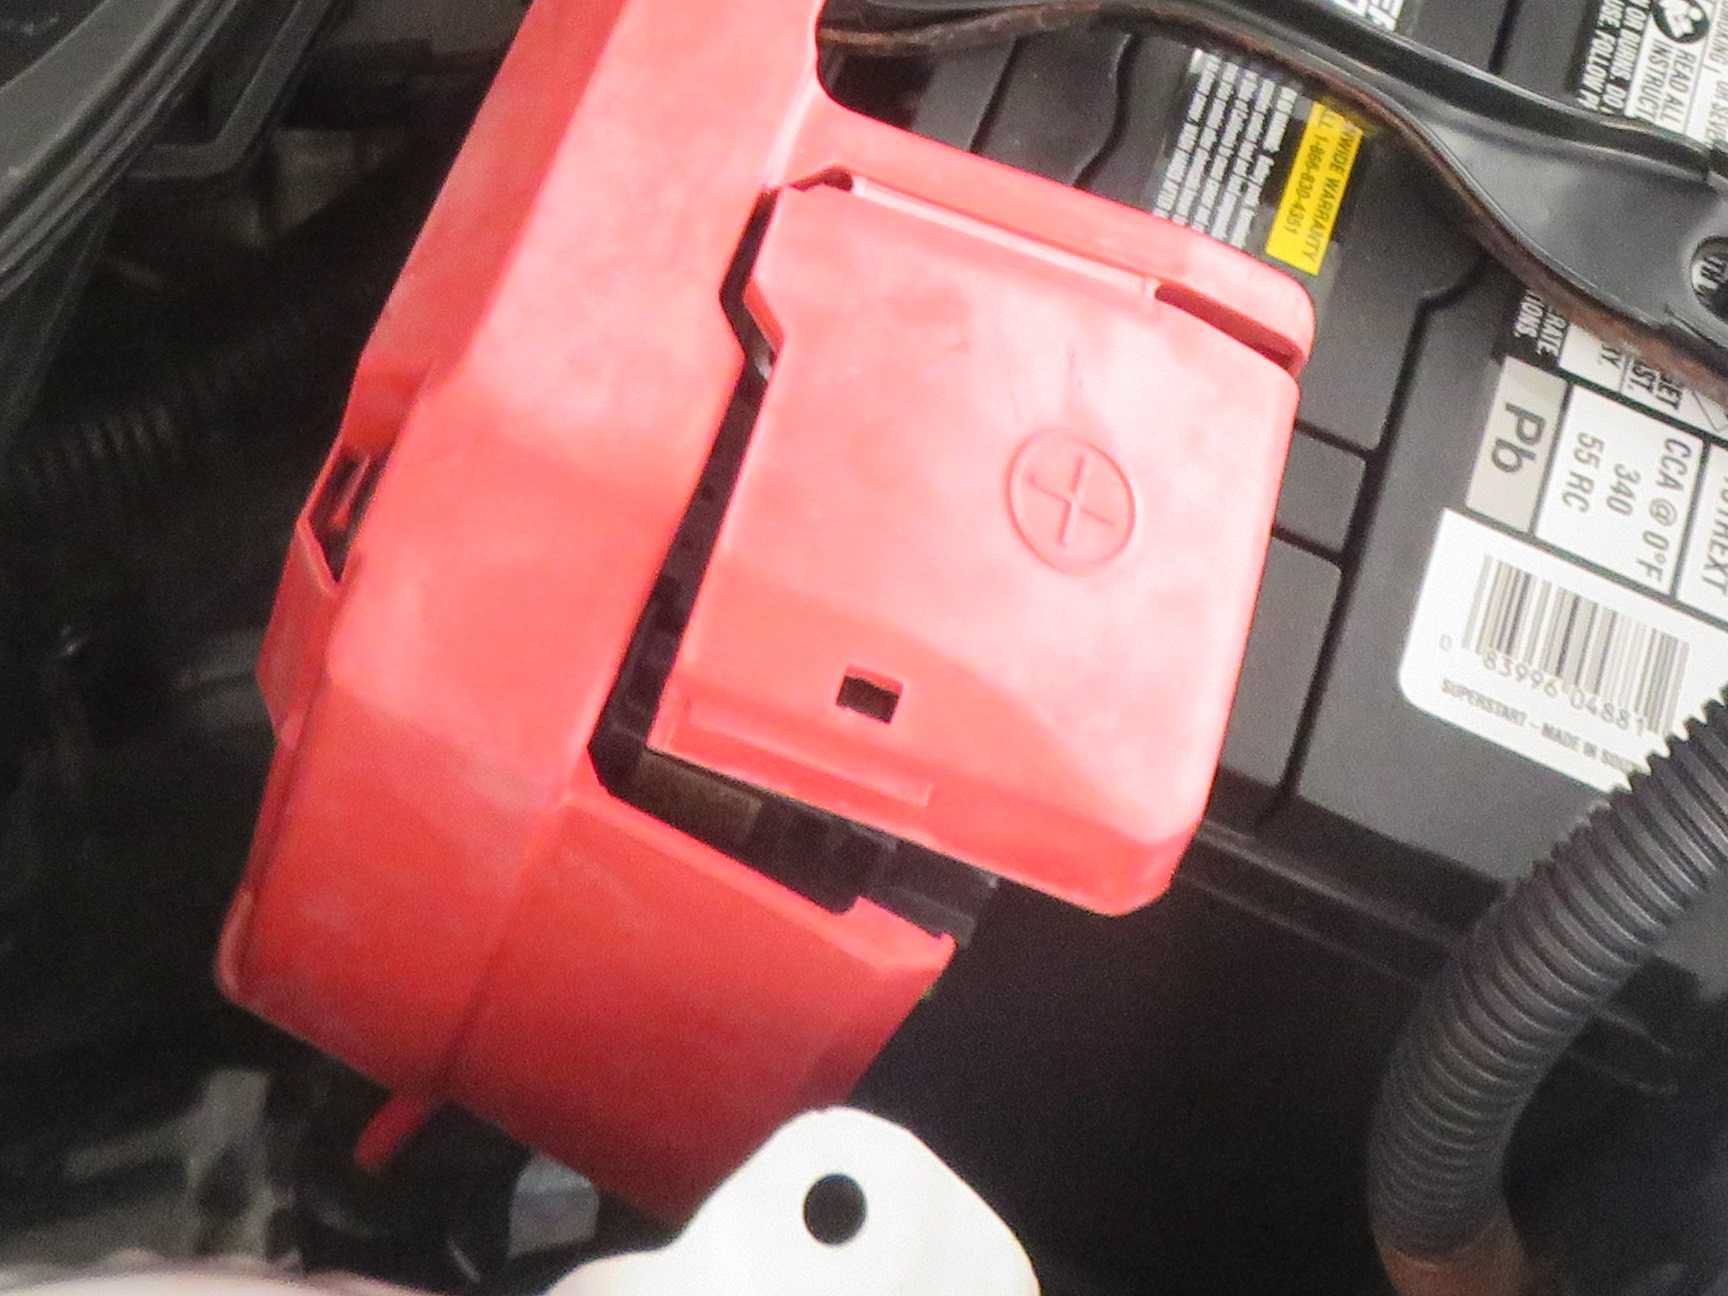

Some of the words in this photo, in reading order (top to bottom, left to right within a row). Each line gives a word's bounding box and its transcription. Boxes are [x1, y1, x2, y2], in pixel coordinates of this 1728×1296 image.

[1621, 4, 1647, 32] OR
[1580, 26, 1617, 89] FOLLOW
[1631, 34, 1674, 124] INSTRUCT
[1666, 46, 1697, 95] READ
[1600, 81, 1627, 111] DO
[1296, 172, 1342, 263] WARRANTY
[1486, 397, 1548, 485] Pb
[1569, 427, 1607, 472] 55
[1652, 433, 1694, 498] CCA
[1558, 468, 1597, 519] RC
[1602, 459, 1643, 520] 340
[1643, 491, 1681, 532] @
